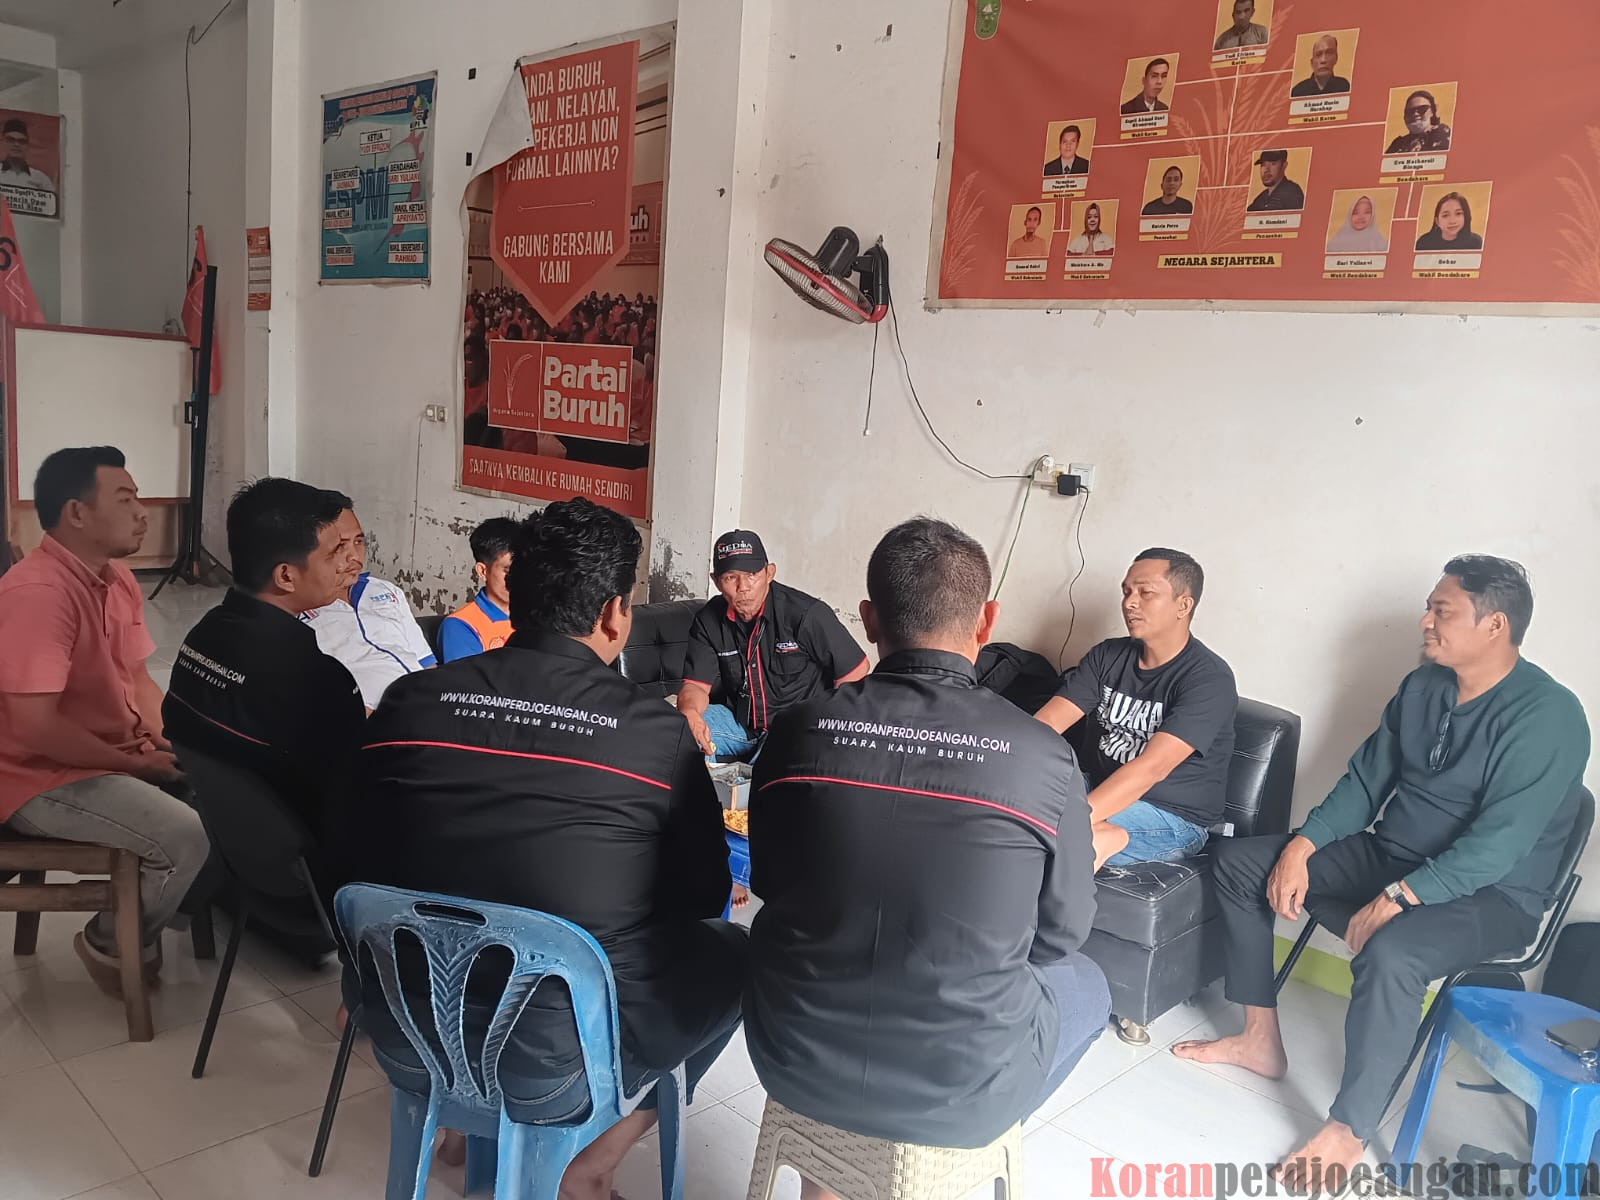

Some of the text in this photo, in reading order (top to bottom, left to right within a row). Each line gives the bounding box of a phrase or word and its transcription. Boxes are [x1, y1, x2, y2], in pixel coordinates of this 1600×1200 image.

[558, 60, 605, 92] BURUH,
[556, 86, 620, 121] NELAYAN,
[534, 115, 619, 151] PEKERJA NON
[506, 145, 619, 184] FORMAL LAINNYA?
[503, 233, 549, 258] GABUNG
[552, 230, 613, 257] BERSAMA
[1164, 256, 1275, 267] NEGARA SEJAHTERA
[539, 260, 571, 284] KAMI
[543, 355, 627, 393] Partai
[543, 389, 625, 428] Buruh
[469, 457, 633, 502] SAATNYA KEMBALI KE RUMAH SENDIRI
[439, 692, 618, 729] WWW.KORANPERDJOEANGAN.COM
[454, 708, 594, 737] SUARA KAUM BURUH
[817, 718, 1011, 754] WWW.KORANPERDJOEANGAN.COM
[833, 736, 985, 763] SUARA KAUM BURUH
